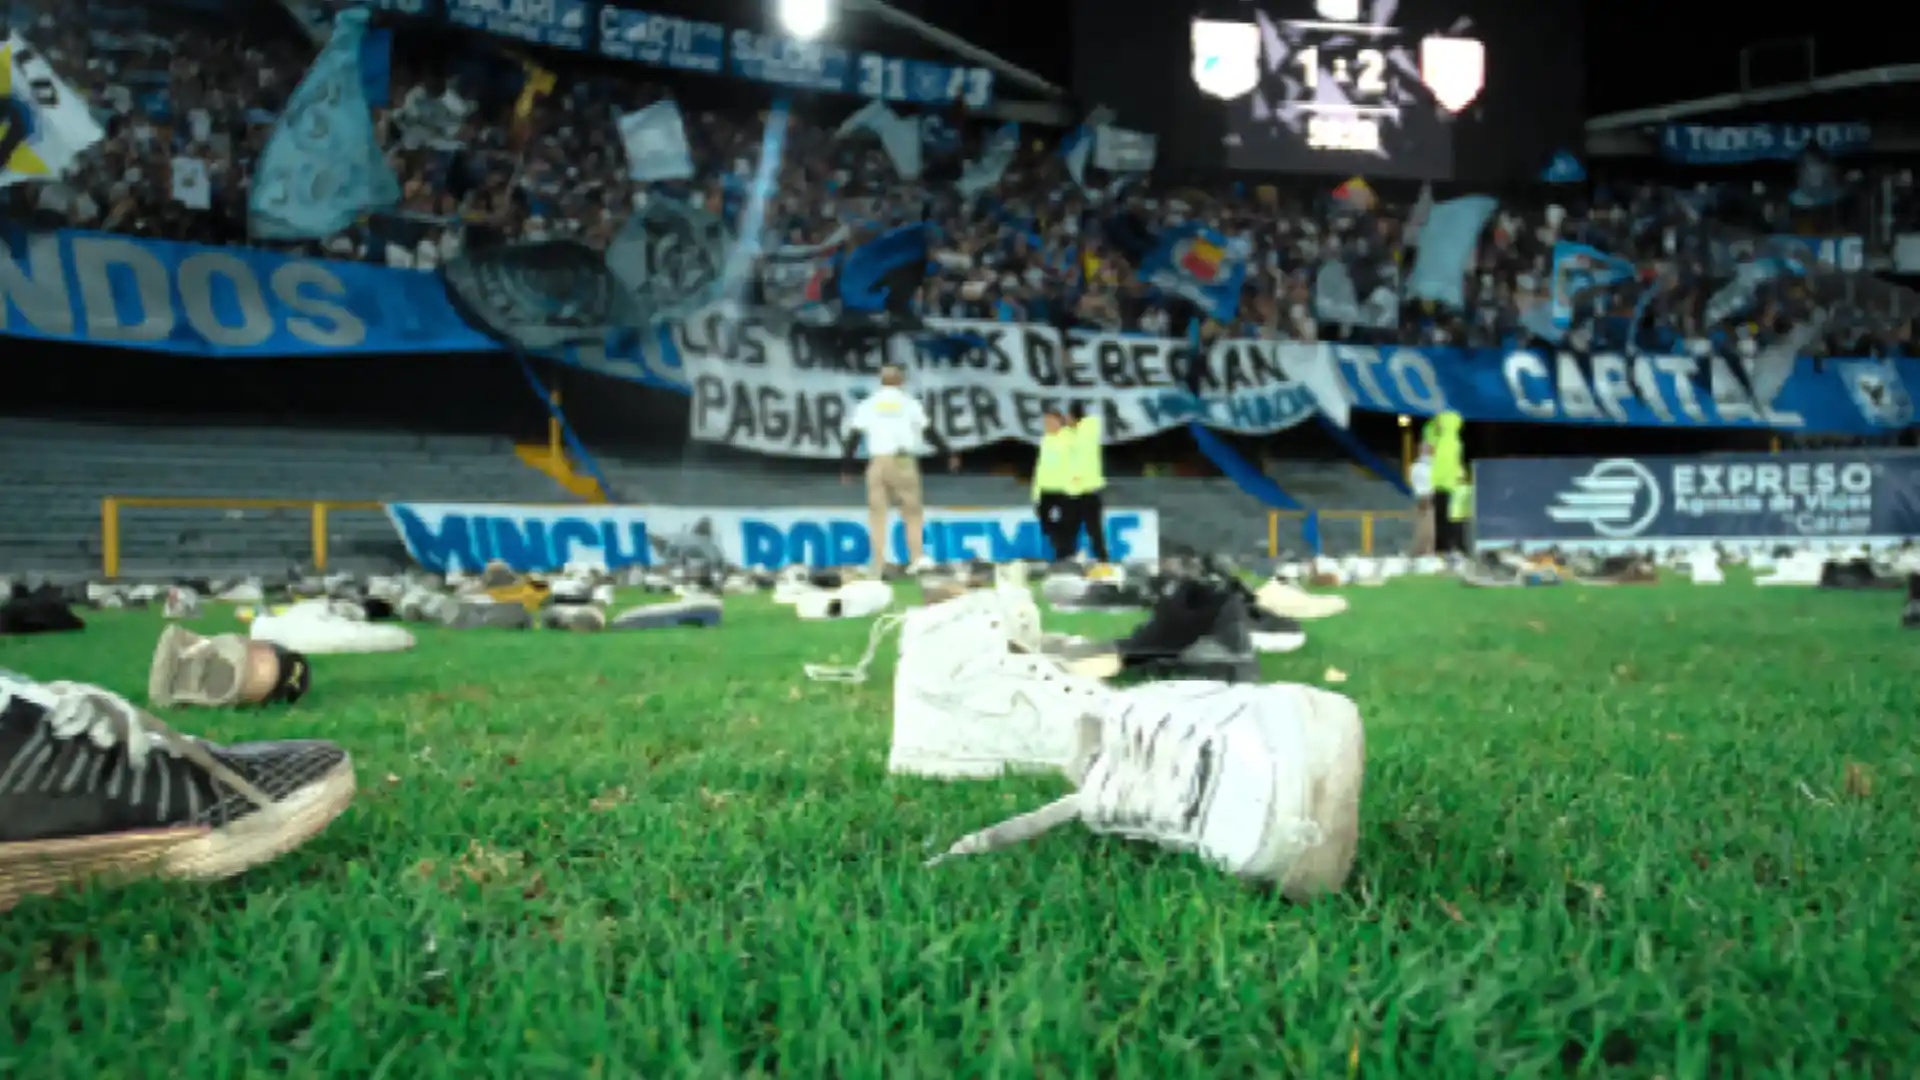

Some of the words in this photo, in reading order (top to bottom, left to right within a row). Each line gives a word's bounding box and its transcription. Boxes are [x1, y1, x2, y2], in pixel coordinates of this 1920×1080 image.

[695, 374, 846, 449] PAGAR
[1011, 391, 1133, 438] ESA
[1502, 350, 1806, 427] CAPITAL
[1673, 463, 1872, 495] EXPRESO
